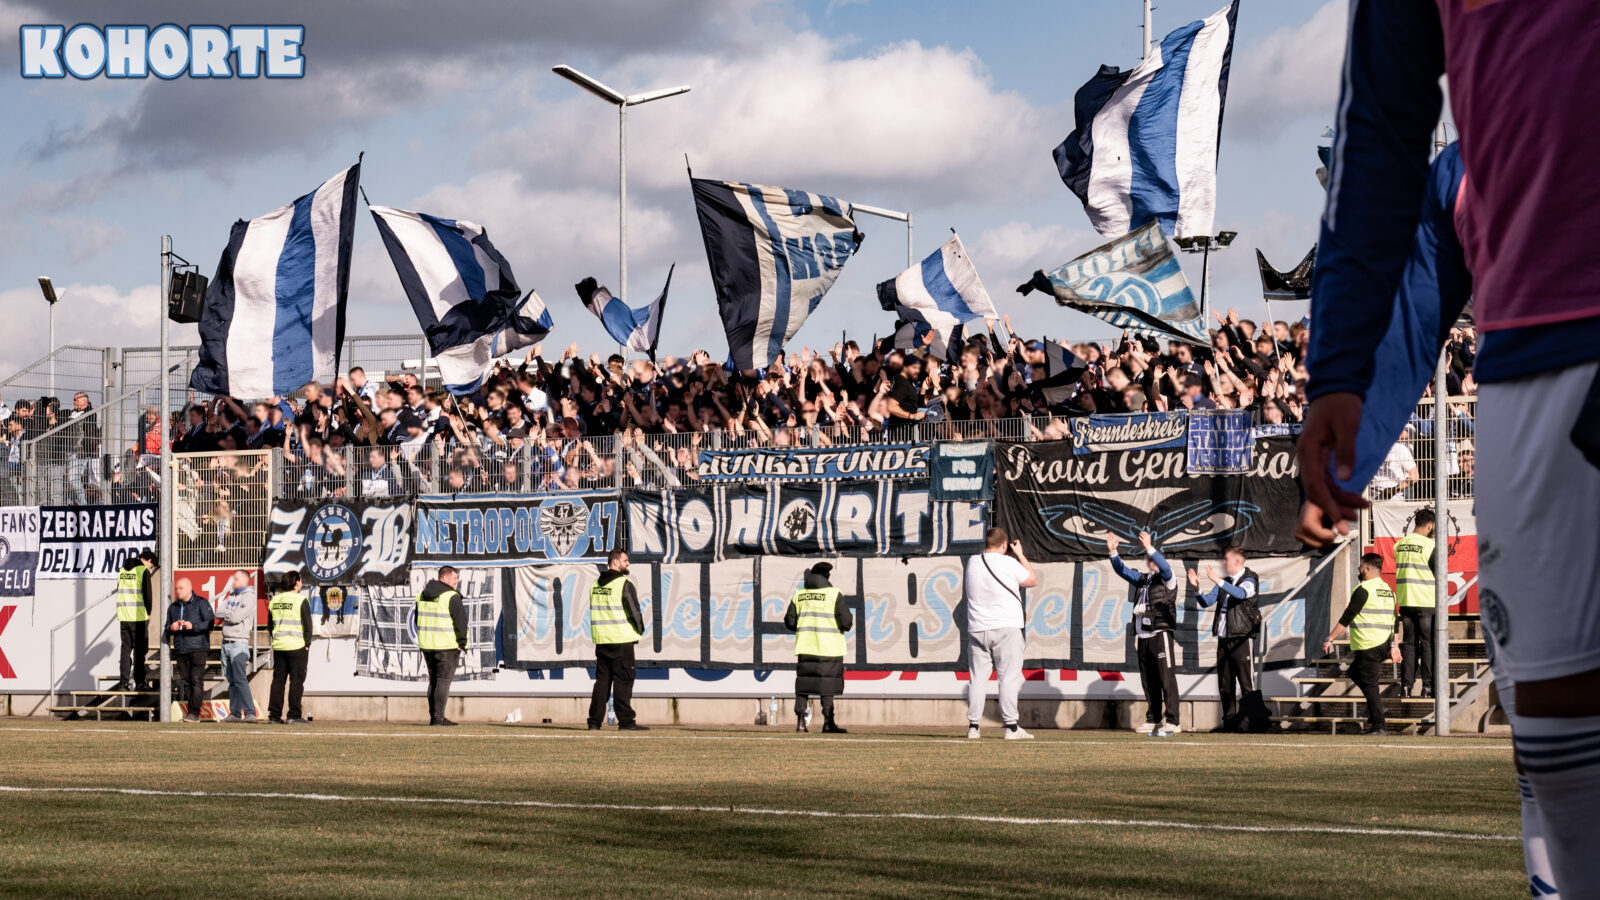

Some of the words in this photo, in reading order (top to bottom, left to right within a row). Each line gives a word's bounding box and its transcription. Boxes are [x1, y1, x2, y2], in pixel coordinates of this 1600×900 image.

[1074, 413, 1185, 448] Freundeskreis
[699, 446, 929, 477] JUNGSPUNDE
[1005, 445, 1109, 484] Proud
[42, 508, 155, 539] ZEBRAFANS
[415, 506, 545, 555] METROPOL
[588, 501, 619, 552] 47
[557, 506, 570, 518] 47
[627, 491, 986, 554] KOHORTE
[40, 548, 95, 574] DELLA
